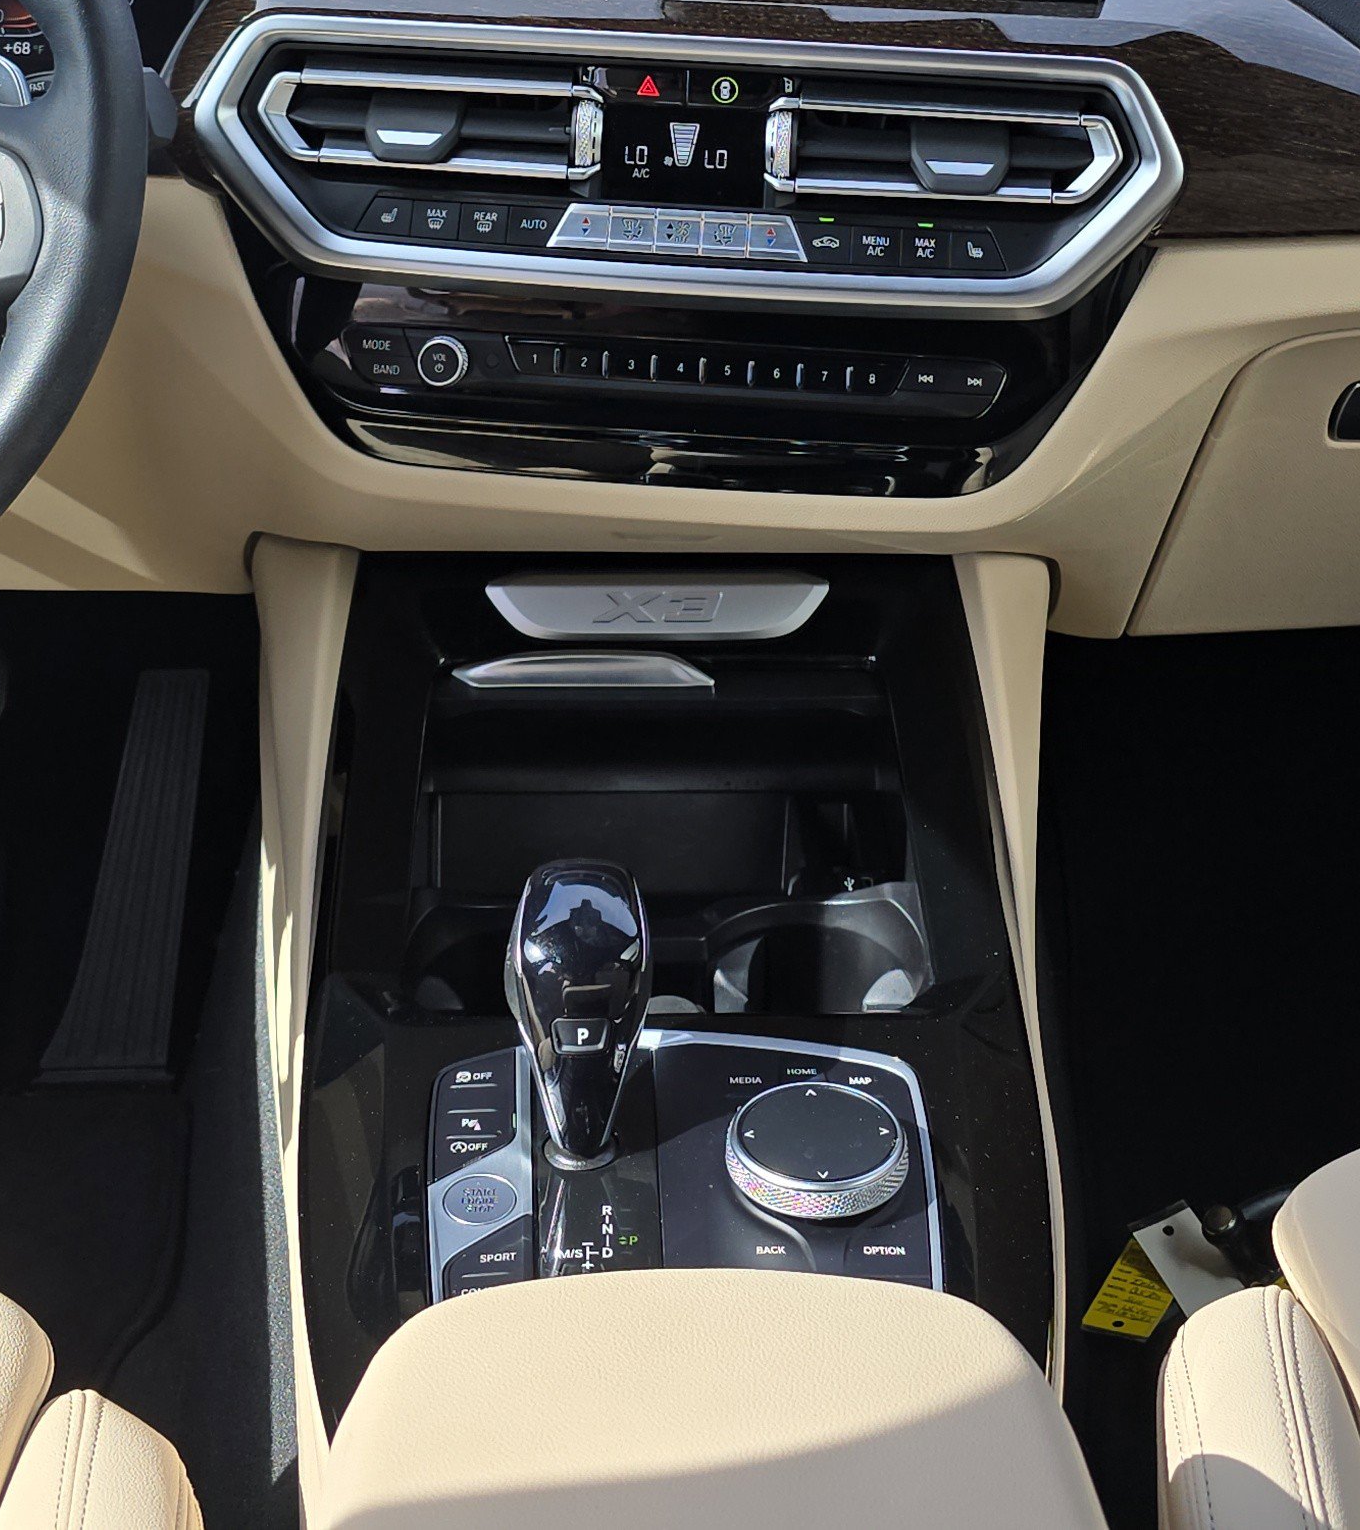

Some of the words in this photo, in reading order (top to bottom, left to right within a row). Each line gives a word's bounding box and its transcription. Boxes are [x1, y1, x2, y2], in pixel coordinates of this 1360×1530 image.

[2, 41, 31, 55] +68
[28, 80, 45, 91] FAST
[624, 145, 649, 165] LO
[703, 149, 728, 170] LO
[631, 168, 650, 179] A/C
[426, 208, 449, 219] MAX
[473, 211, 498, 222] REAR
[519, 218, 548, 231] AUTO
[861, 235, 890, 246] MENU
[914, 237, 937, 248] MAX
[866, 246, 885, 257] A/C
[915, 248, 935, 259] A/C
[362, 338, 391, 351] MODE
[432, 353, 447, 362] VOL
[372, 363, 400, 376] BAND
[531, 353, 538, 365] 1
[580, 356, 588, 368] 2
[628, 359, 635, 370] 3
[676, 362, 684, 374] 4
[724, 365, 731, 376] 5
[772, 368, 781, 379] 6
[821, 371, 828, 382] 7
[868, 373, 876, 385] 8
[592, 590, 724, 623] X3
[577, 1027, 590, 1045] P
[472, 1071, 493, 1081] OFF
[786, 1067, 817, 1076] HOME
[729, 1076, 762, 1085] MEDIA
[848, 1076, 872, 1085] MAP
[467, 1141, 489, 1152] OFF
[601, 1204, 613, 1216] R
[601, 1223, 614, 1235] N
[629, 1235, 639, 1246] P
[601, 1247, 614, 1259] D
[755, 1245, 786, 1257] BACK
[863, 1245, 906, 1257] OPTION
[479, 1251, 518, 1264] SPORT
